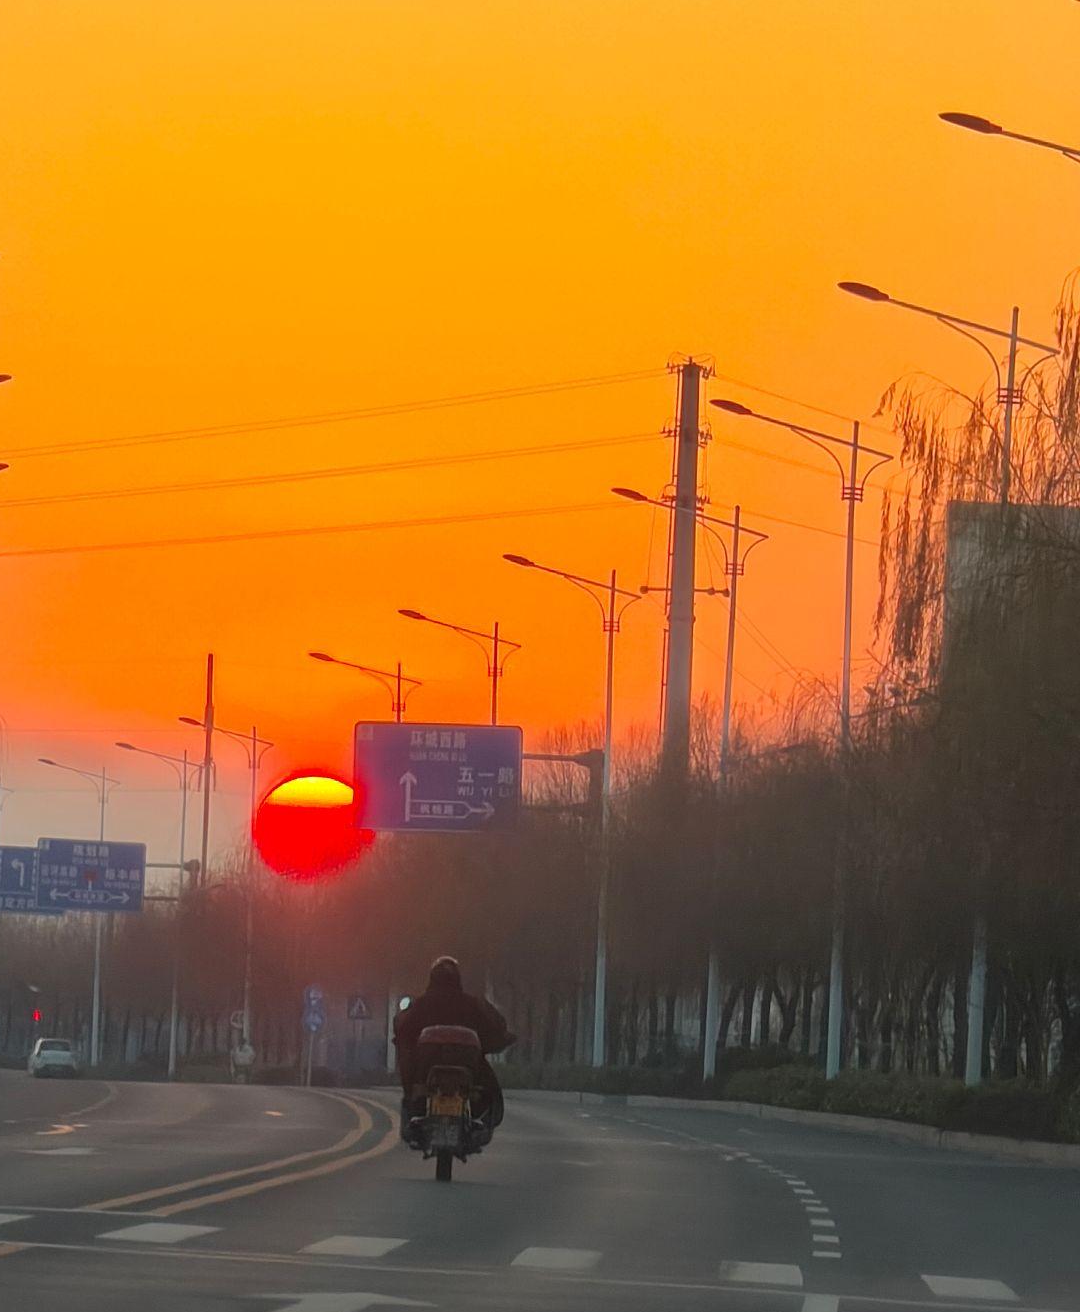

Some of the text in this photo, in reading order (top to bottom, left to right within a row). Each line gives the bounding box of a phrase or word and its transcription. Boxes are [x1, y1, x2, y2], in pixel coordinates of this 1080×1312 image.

[457, 767, 514, 784] 五一路
[457, 785, 474, 796] WU
[481, 786, 493, 797] YI
